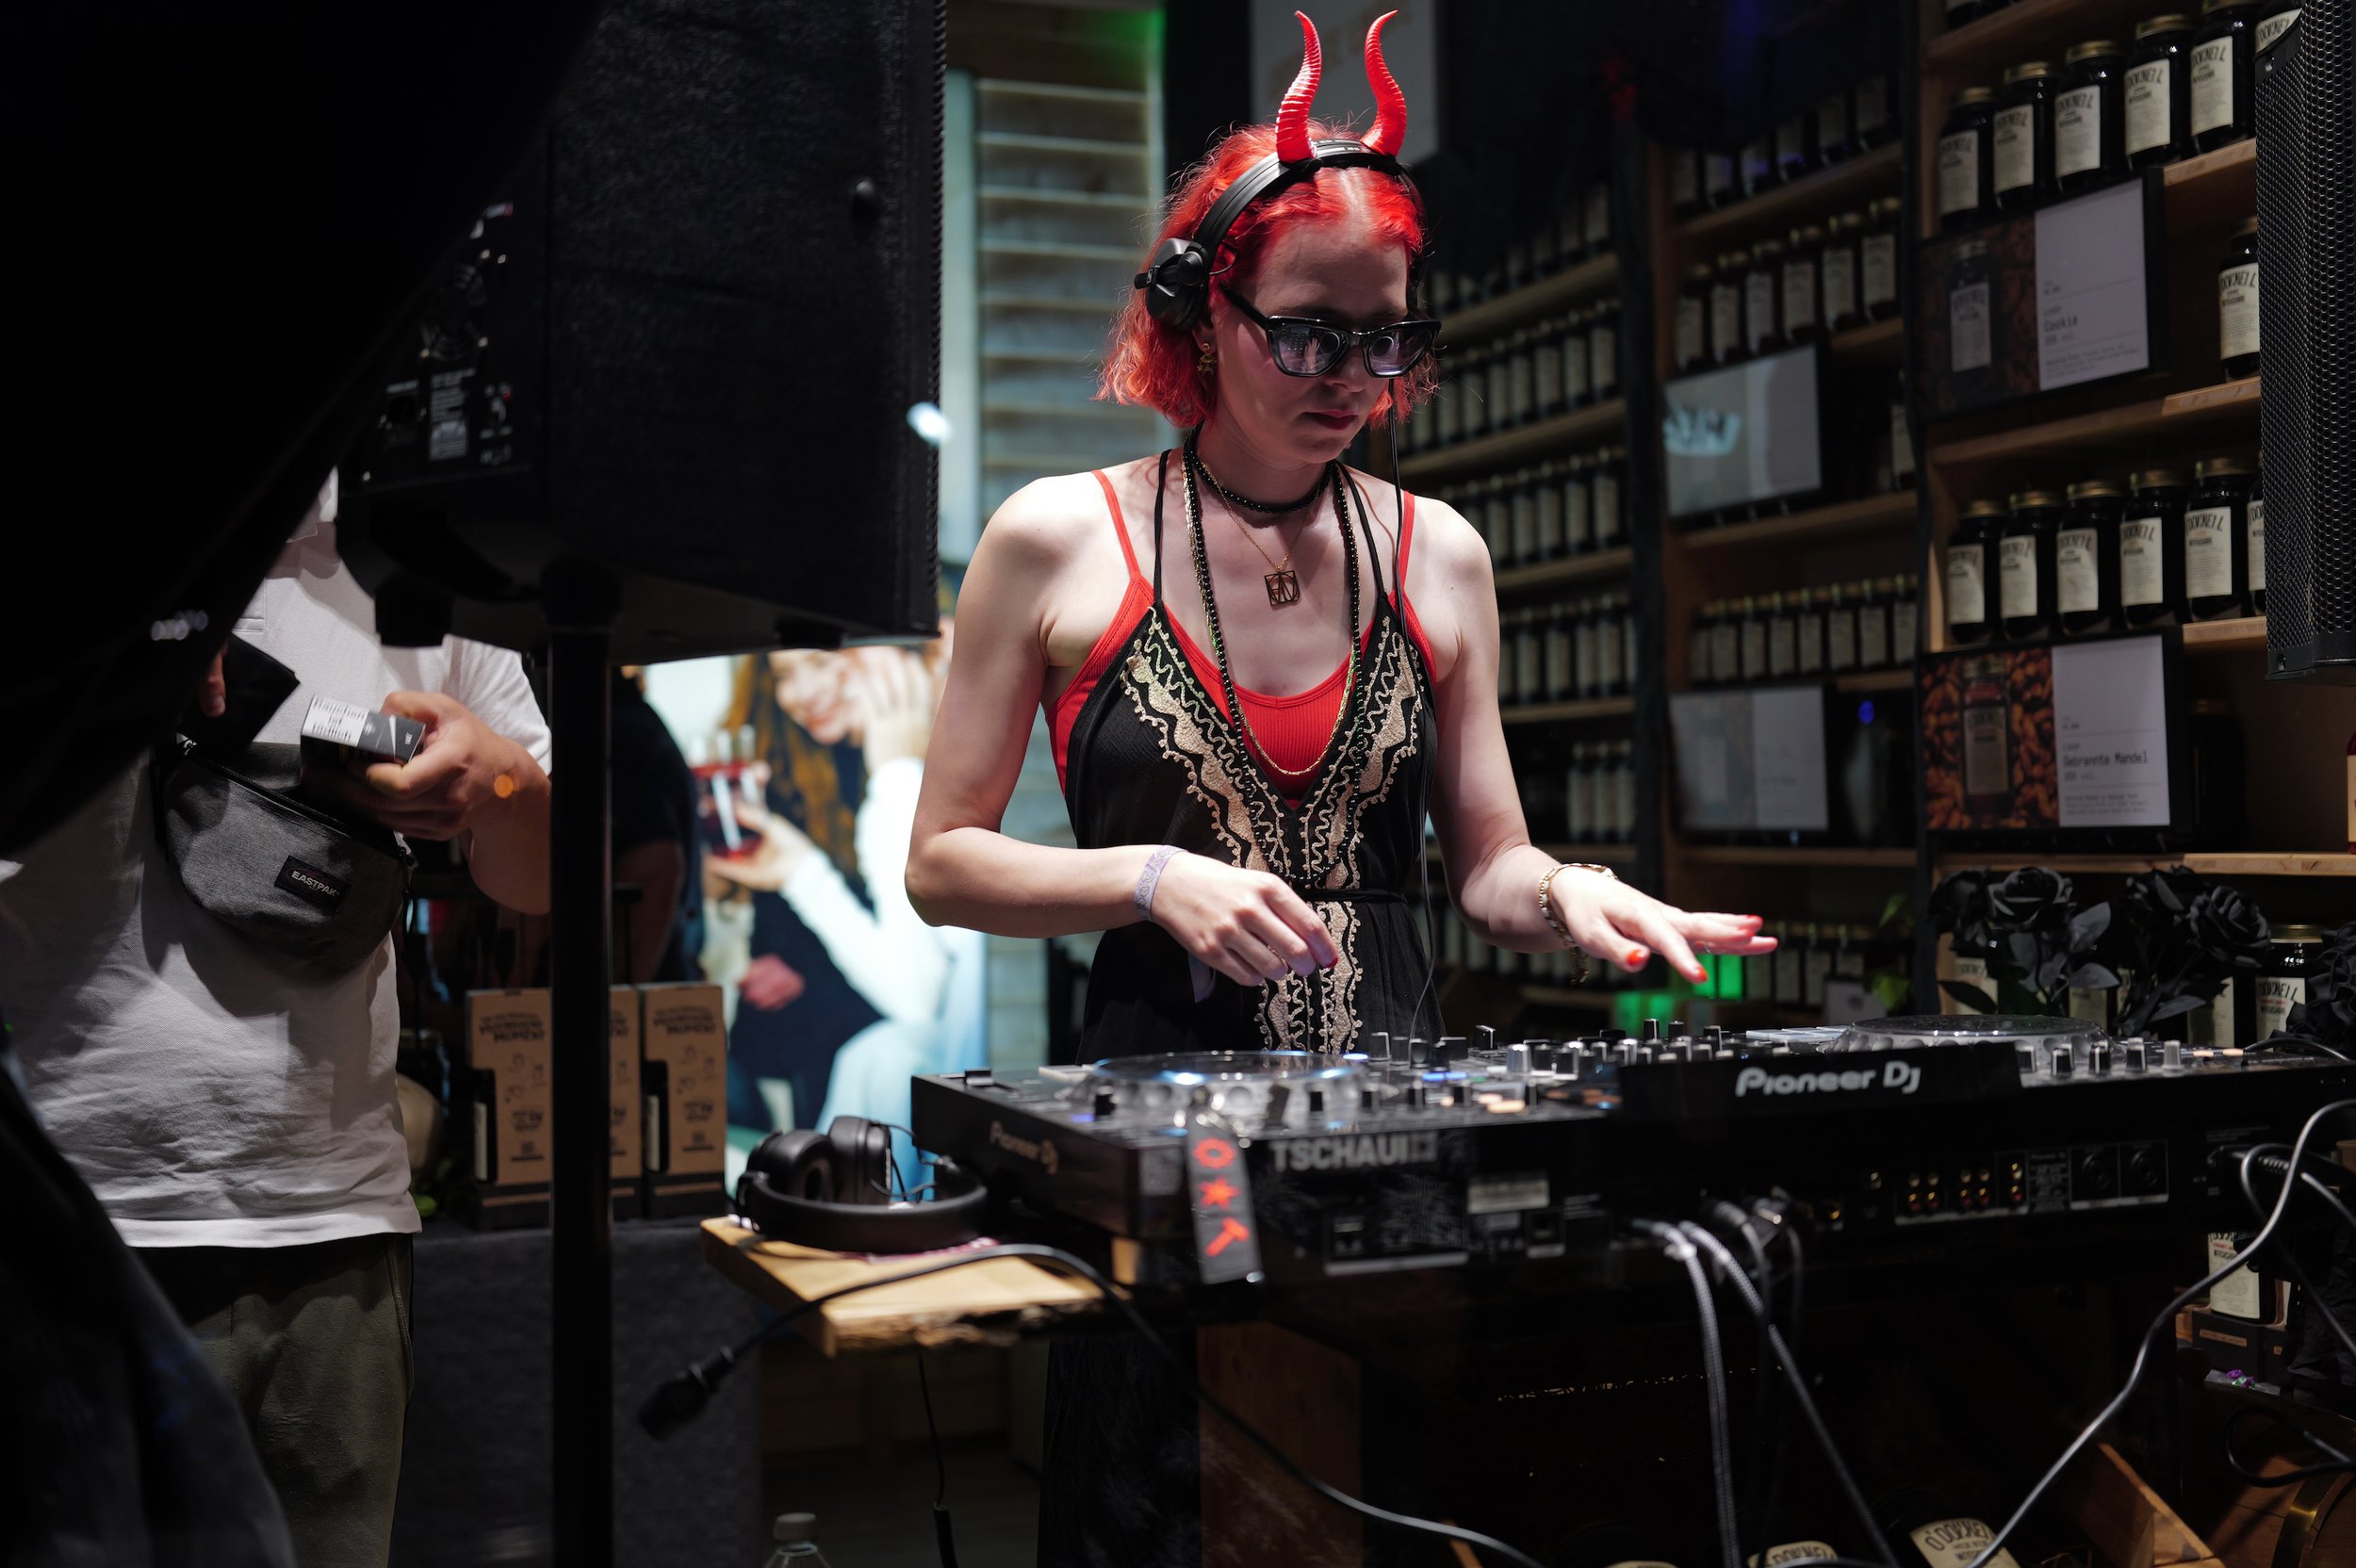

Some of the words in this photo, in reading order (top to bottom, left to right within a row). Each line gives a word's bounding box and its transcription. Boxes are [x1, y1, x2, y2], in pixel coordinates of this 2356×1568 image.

[2116, 750, 2148, 765] Mandel
[291, 870, 339, 897] EASTPAK
[1734, 1066, 1877, 1098] Pioneer
